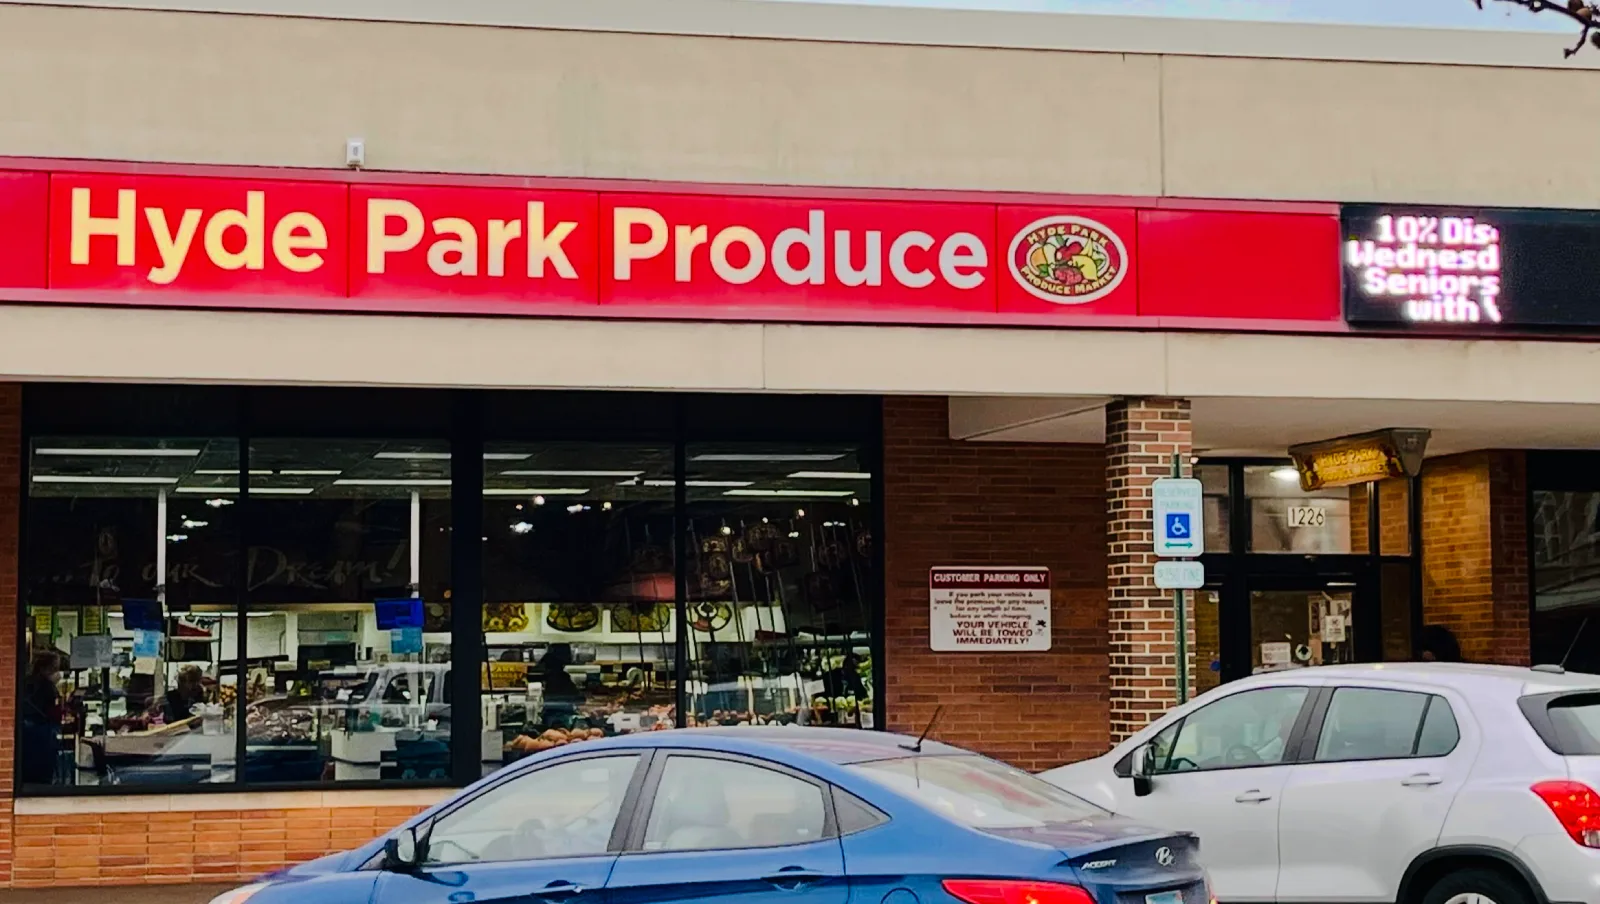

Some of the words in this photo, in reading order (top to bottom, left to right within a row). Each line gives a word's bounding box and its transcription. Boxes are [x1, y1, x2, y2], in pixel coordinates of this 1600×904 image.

[70, 187, 328, 285] Hyde
[366, 198, 579, 280] Park
[613, 206, 988, 288] Produce
[1027, 225, 1066, 245] HYDE
[1071, 224, 1109, 247] PARK
[1376, 215, 1438, 244] 10%
[1347, 239, 1500, 271] Wednesd
[1020, 265, 1071, 295] PRODUCE
[1074, 265, 1117, 294] MARKET
[1363, 266, 1500, 295] Seniors
[1405, 294, 1481, 323] with
[1291, 507, 1324, 526] 1226
[933, 573, 980, 582] CUSTOMER
[983, 573, 1020, 582] PARKING
[1023, 573, 1046, 582] ONLY
[953, 629, 978, 637] WILL
[980, 629, 993, 637] BE
[997, 629, 1033, 637] TOWED
[957, 621, 984, 629] YOUR
[987, 621, 1029, 629] VEHICLE
[956, 637, 1029, 645] IMMEDIATELY!
[1080, 859, 1117, 871] ACCENT
